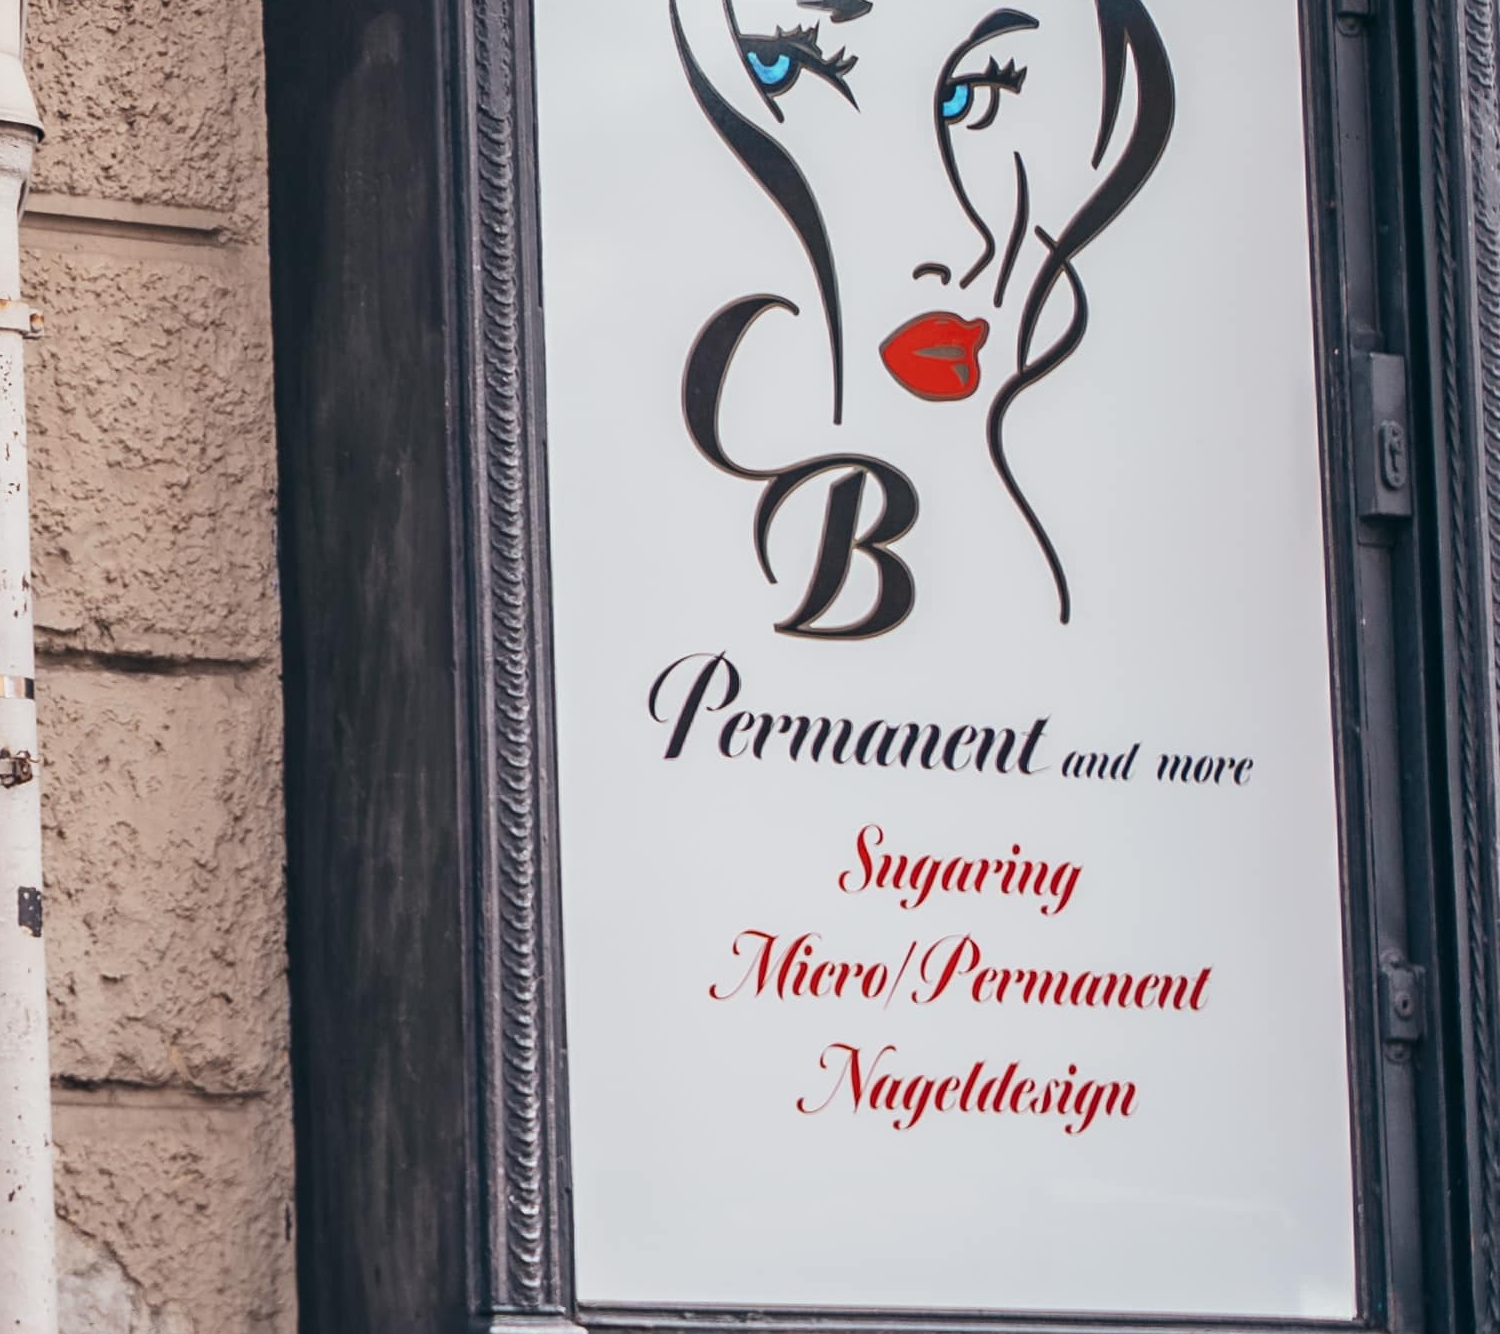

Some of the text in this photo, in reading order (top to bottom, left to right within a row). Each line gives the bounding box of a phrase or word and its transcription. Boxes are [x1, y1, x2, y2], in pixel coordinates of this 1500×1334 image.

[648, 651, 1255, 787] Permanent and more
[837, 822, 1083, 916] Sugaring
[707, 928, 1213, 1011] Micro/Permanent
[796, 1042, 1138, 1134] Nageldesign
